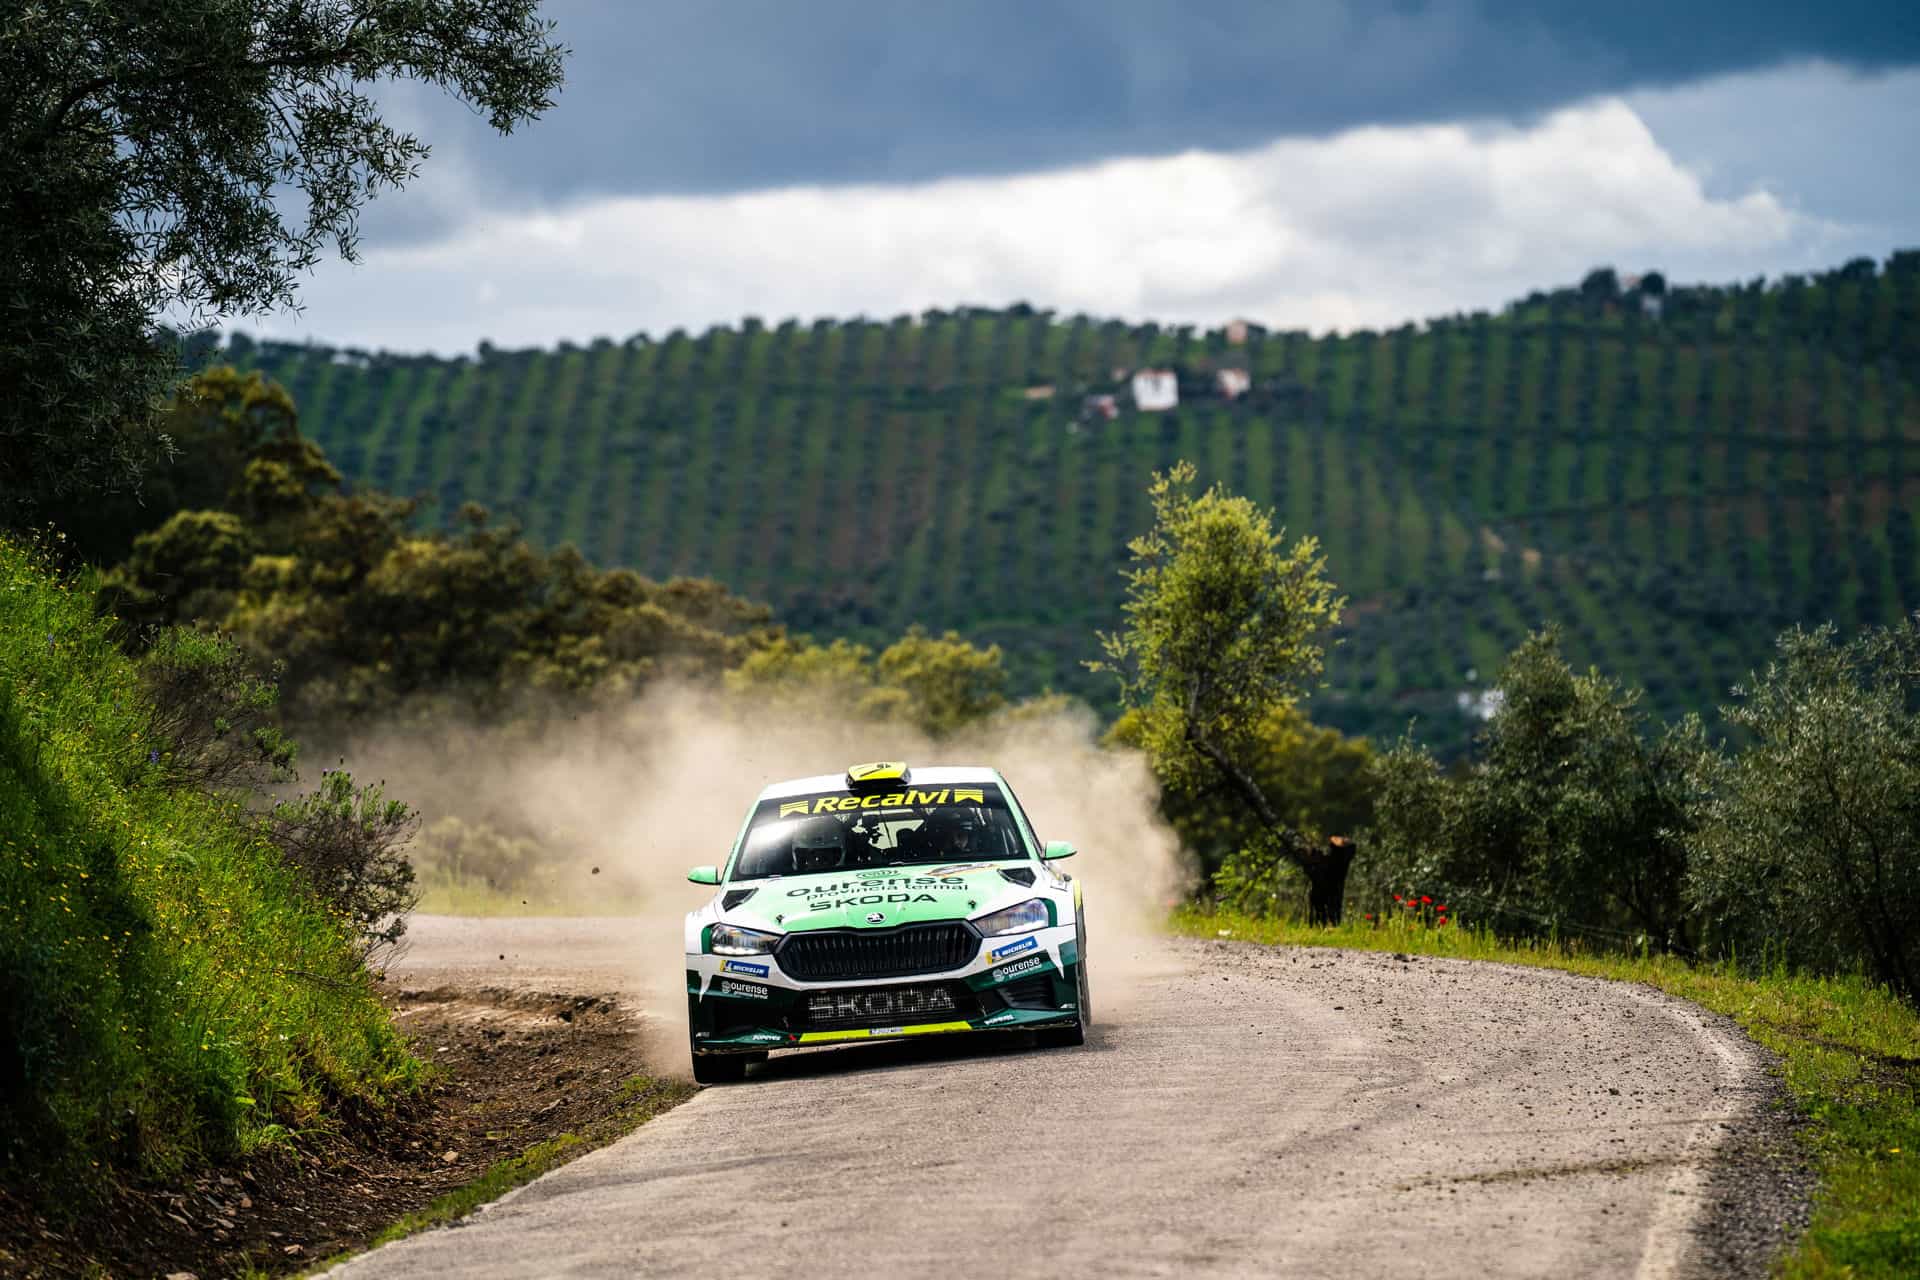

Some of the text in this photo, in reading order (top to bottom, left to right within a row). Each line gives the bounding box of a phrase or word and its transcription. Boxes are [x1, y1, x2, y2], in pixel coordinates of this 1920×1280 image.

[812, 789, 950, 814] Recalvi
[786, 877, 965, 897] ourense
[807, 884, 898, 901] provincia
[1002, 941, 1033, 955] MICHELIN
[733, 965, 765, 974] MICHELIN
[1003, 957, 1040, 975] ourense
[731, 982, 768, 995] ourense
